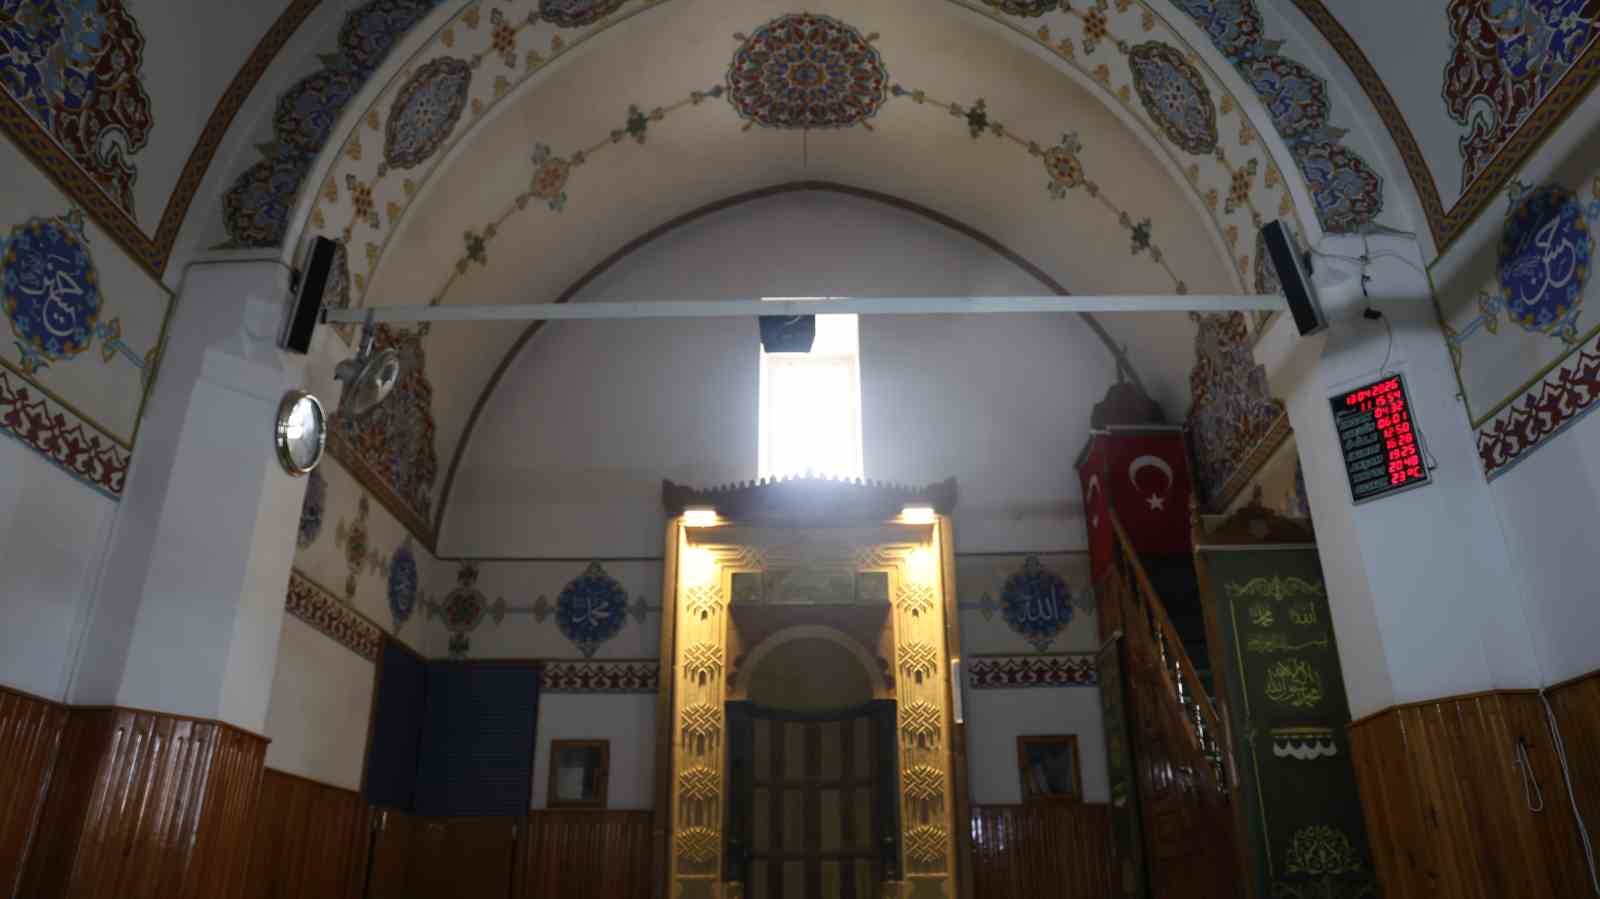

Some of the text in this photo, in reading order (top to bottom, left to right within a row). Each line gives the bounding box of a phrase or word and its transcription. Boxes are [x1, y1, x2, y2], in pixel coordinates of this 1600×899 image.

[1377, 411, 1407, 429] 06 01
[1400, 443, 1416, 457] 25
[1391, 470, 1406, 485] 23
